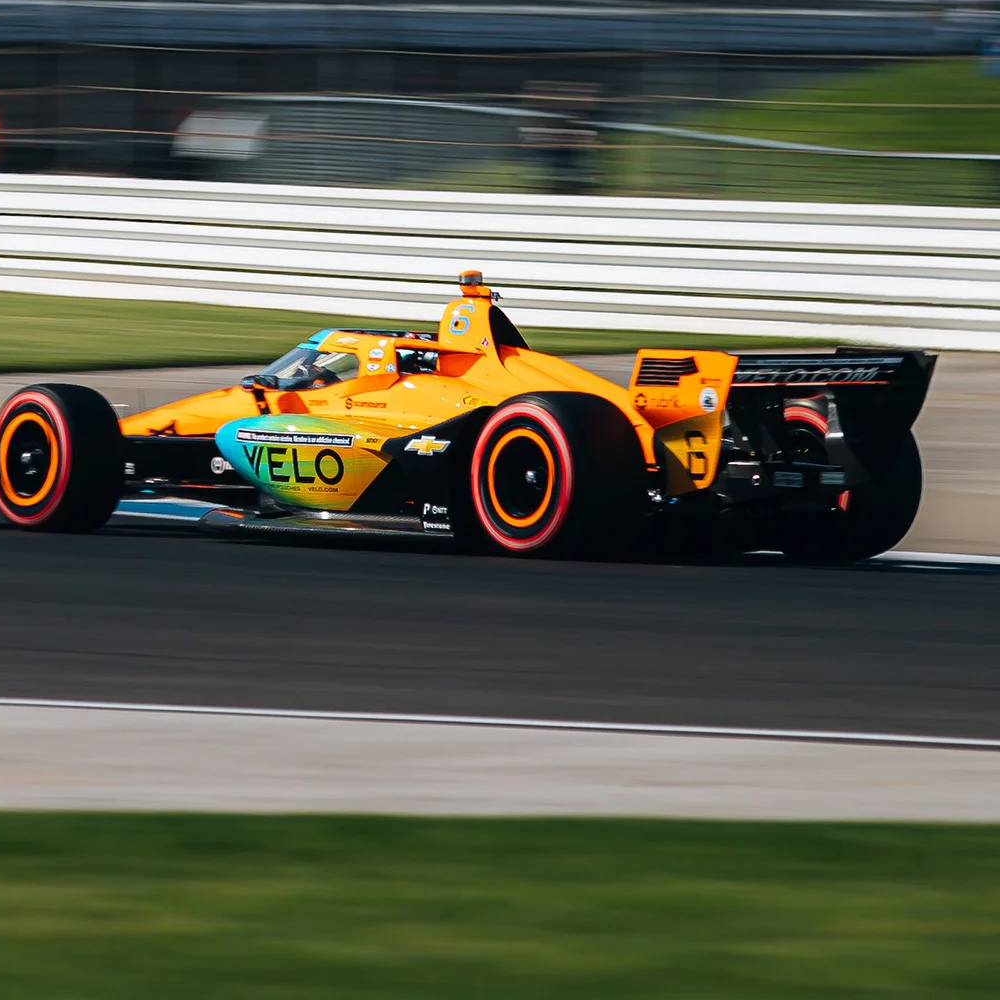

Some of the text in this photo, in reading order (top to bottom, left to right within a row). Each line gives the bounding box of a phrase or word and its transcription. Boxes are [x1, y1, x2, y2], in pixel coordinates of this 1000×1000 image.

[449, 304, 475, 335] 6
[242, 445, 345, 486] VELO
[684, 430, 708, 481] 6
